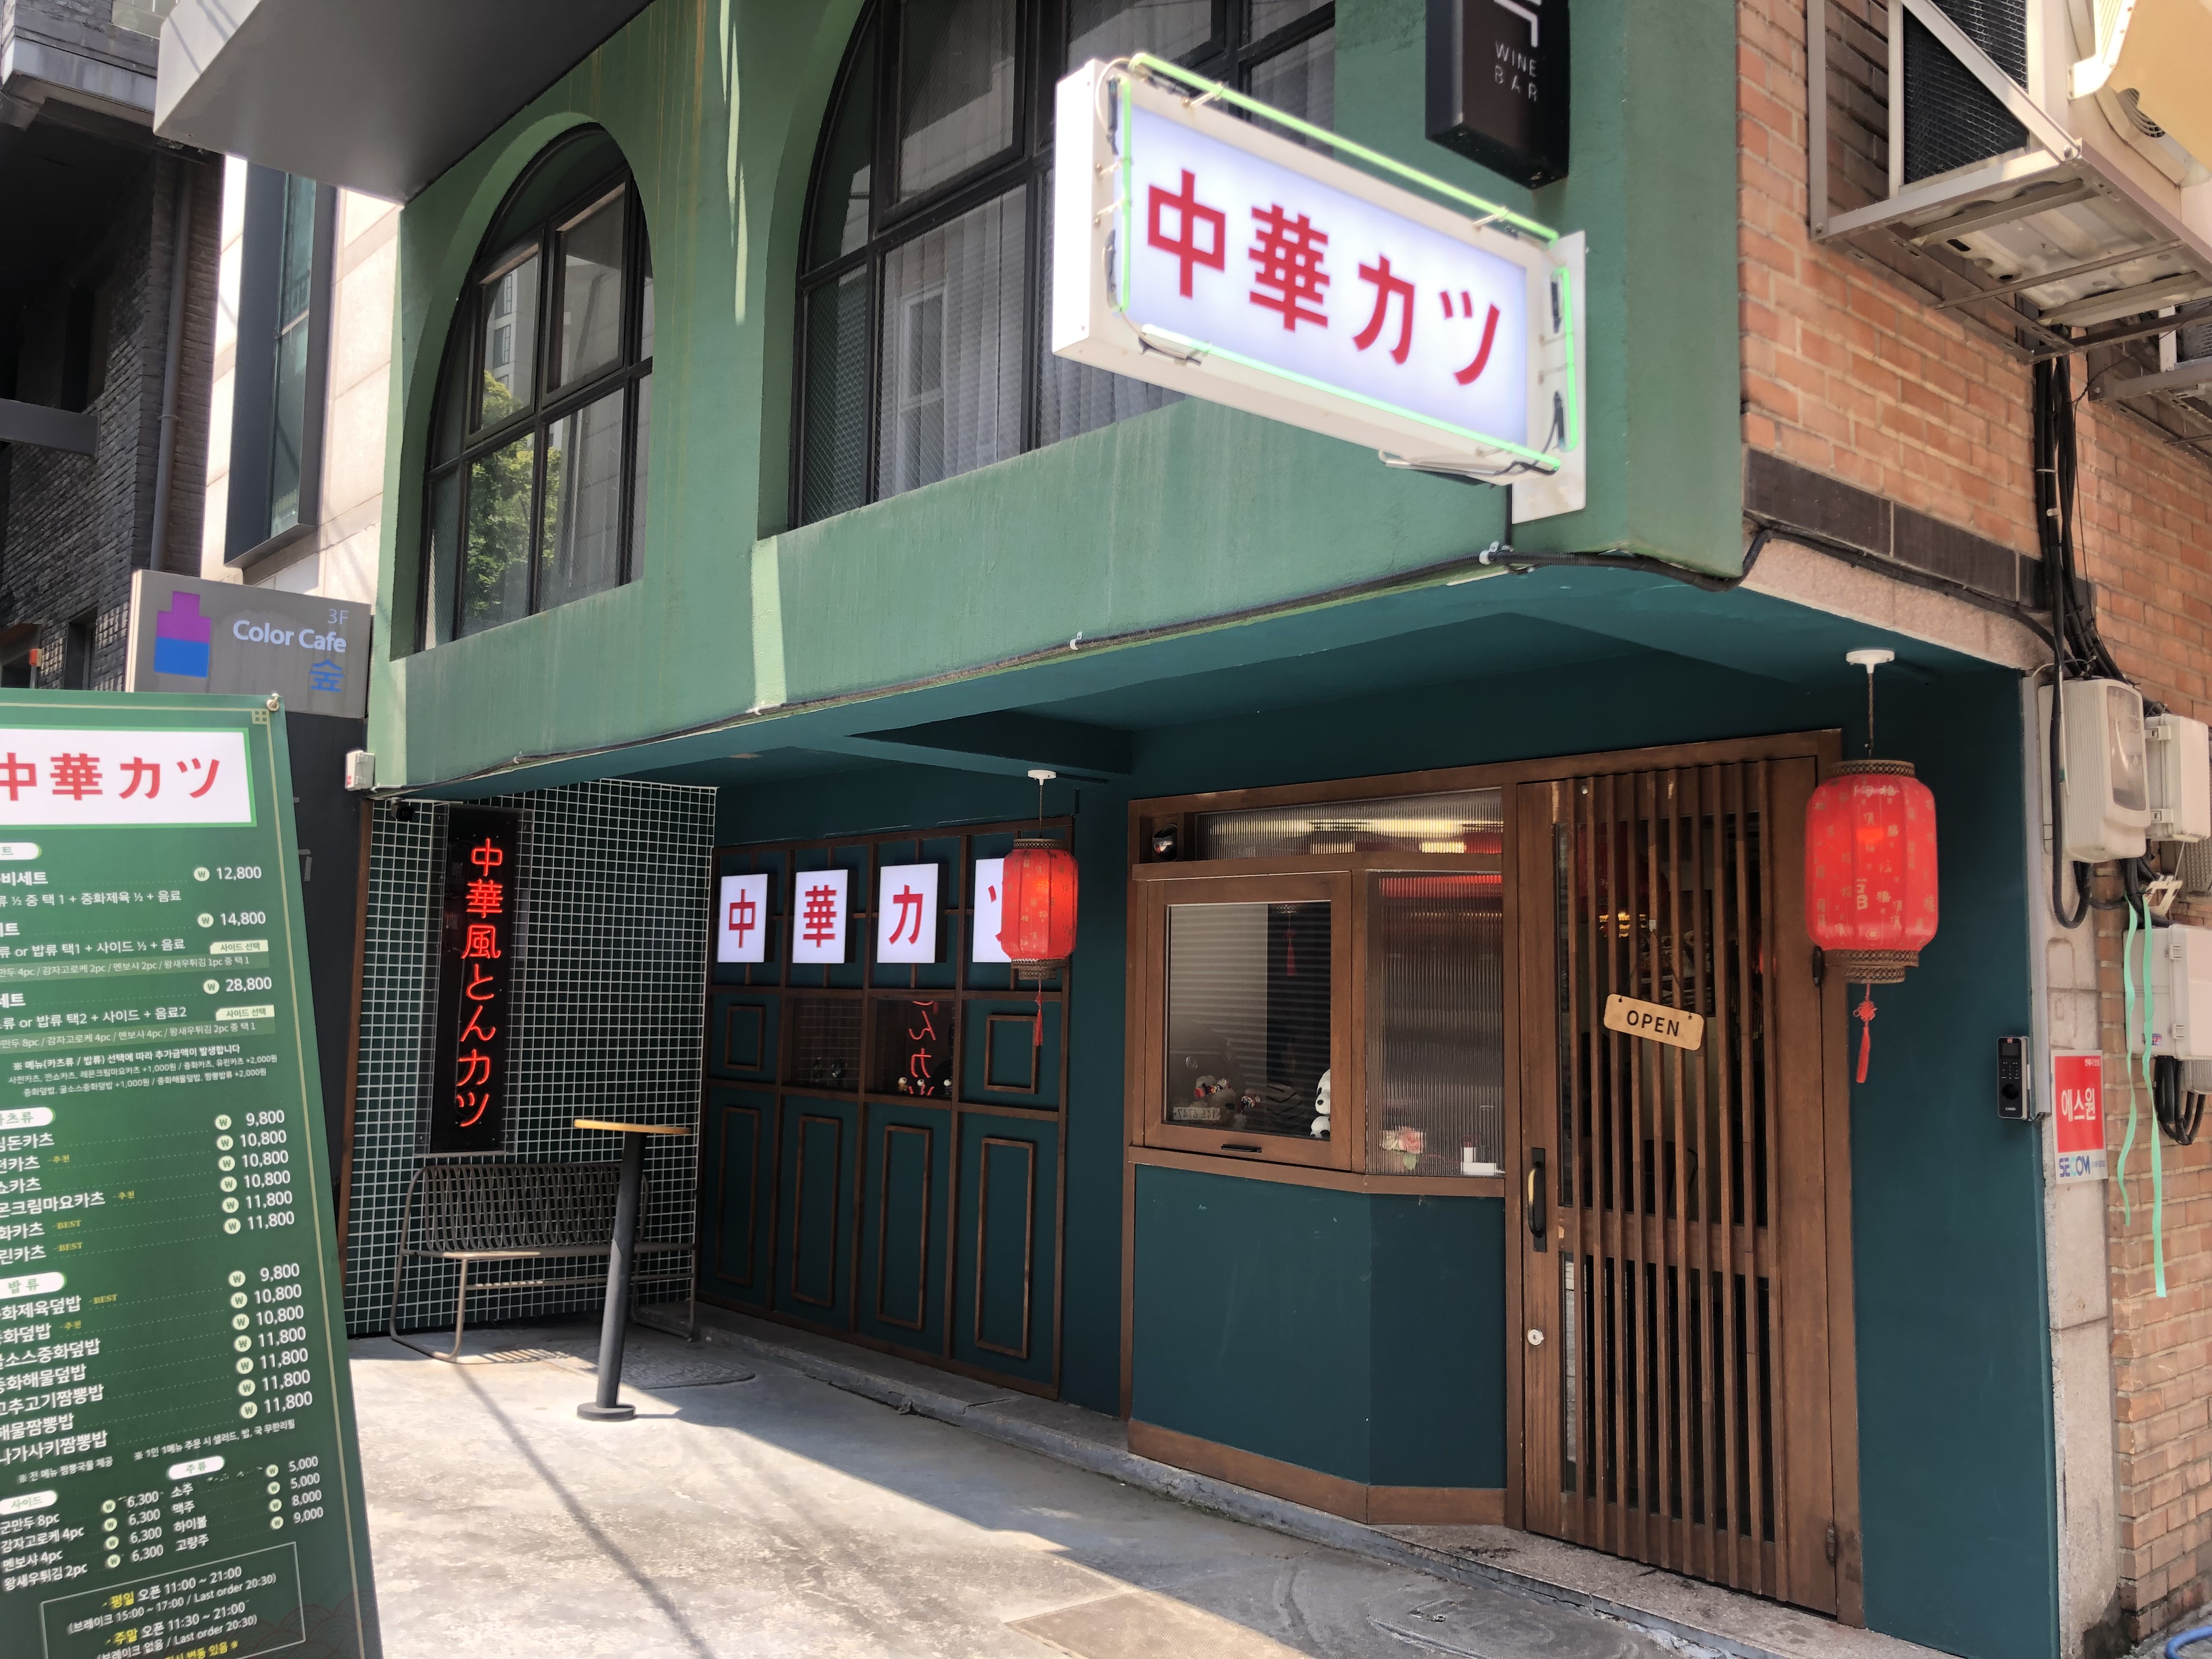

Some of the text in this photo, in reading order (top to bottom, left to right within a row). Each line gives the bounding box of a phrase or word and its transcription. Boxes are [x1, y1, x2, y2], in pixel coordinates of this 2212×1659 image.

[1495, 40, 1536, 77] WINE
[1495, 65, 1537, 102] BAR
[1147, 168, 1501, 387] 中華カツ
[327, 608, 349, 625] 3F
[233, 619, 347, 653] Color Cafe
[0, 752, 220, 802] 中華カツ
[216, 866, 262, 881] 12,800
[25, 890, 182, 907] 중 택 중화제육 음료
[220, 911, 266, 927] 14,800
[15, 948, 28, 957] or
[32, 944, 58, 958] 밥류
[97, 941, 134, 954] 사이드
[161, 939, 185, 951] 음료
[221, 942, 260, 952] 사이드 선택
[18, 968, 35, 978] 4pc
[43, 964, 88, 976] 감자고로케
[90, 965, 106, 975] 2pc
[114, 962, 139, 972] 멘보샤
[142, 962, 157, 972] 2pc
[164, 958, 206, 969] 왕새우튀김
[208, 958, 223, 968] 1pc
[224, 957, 233, 966] 중
[235, 956, 243, 964] 택
[456, 838, 503, 1127] 中華風とんカツ
[225, 977, 272, 992] 28,800
[19, 1019, 33, 1028] or
[37, 1015, 63, 1028] 밥류
[103, 1009, 140, 1023] 사이드
[155, 1007, 187, 1020] 음료2
[226, 1007, 266, 1018] 사이드 선택
[1627, 1010, 1680, 1037] OPEN
[22, 1022, 249, 1049] 8pc 감자고로케 4pc 멘보샤 4pc 왕새우튀김 2pc 중 택
[108, 1052, 133, 1064] 선택에
[136, 1050, 153, 1061] 따라
[155, 1047, 197, 1060] 추가금액이
[199, 1043, 240, 1057] 발생합니다
[246, 1109, 285, 1127] 9,800
[2061, 1088, 2096, 1122] 에스원
[240, 1129, 287, 1148] 10,800
[241, 1150, 289, 1168] 10,800
[243, 1170, 291, 1189] 10,800
[55, 1219, 82, 1230] BEST
[245, 1190, 293, 1209] 11,800
[58, 1241, 83, 1252] BEST
[247, 1210, 295, 1231] 11,800
[0, 1263, 300, 1321] 화제육덮밥 BEST 9,800
[0, 1283, 302, 1344] 화덮밥 10,800
[256, 1305, 304, 1325] 10,800
[258, 1326, 306, 1347] 11,800
[260, 1347, 308, 1370] 11,800
[262, 1369, 311, 1392] 11,800
[0, 1390, 313, 1466] 나가사키짬뽕밥 11,800
[145, 1418, 295, 1458] 1인 1메뉴 주문 시 국 무한리필
[29, 1470, 39, 1482] 전
[41, 1468, 58, 1479] 메뉴
[170, 1455, 319, 1499] 소주 5,000
[11, 1495, 44, 1509] 사이드
[171, 1472, 320, 1516] 맥주 5,000
[0, 1490, 159, 1536] 군만두 8pc 6,300
[173, 1489, 322, 1533] 하이볼 8,000
[1, 1508, 161, 1554] 감자고로케 4pc 6,300
[175, 1506, 324, 1553] 고량주 9,000
[1, 1526, 162, 1573] 멘보샤 4pc 6,300
[2, 1544, 164, 1592] 왕새우튀김 2pc 6,300
[109, 1566, 242, 1609] 평일 오픈 11:00 21:00
[115, 1606, 145, 1622] 15:00
[155, 1596, 184, 1613] 17:00
[193, 1589, 215, 1604] Last
[216, 1583, 243, 1598] order
[112, 1601, 246, 1646] 주말 오픈 11:30 21:00
[143, 1638, 163, 1655] 없음
[173, 1631, 195, 1646] Last
[196, 1624, 224, 1640] order
[208, 1641, 228, 1657] 있음
